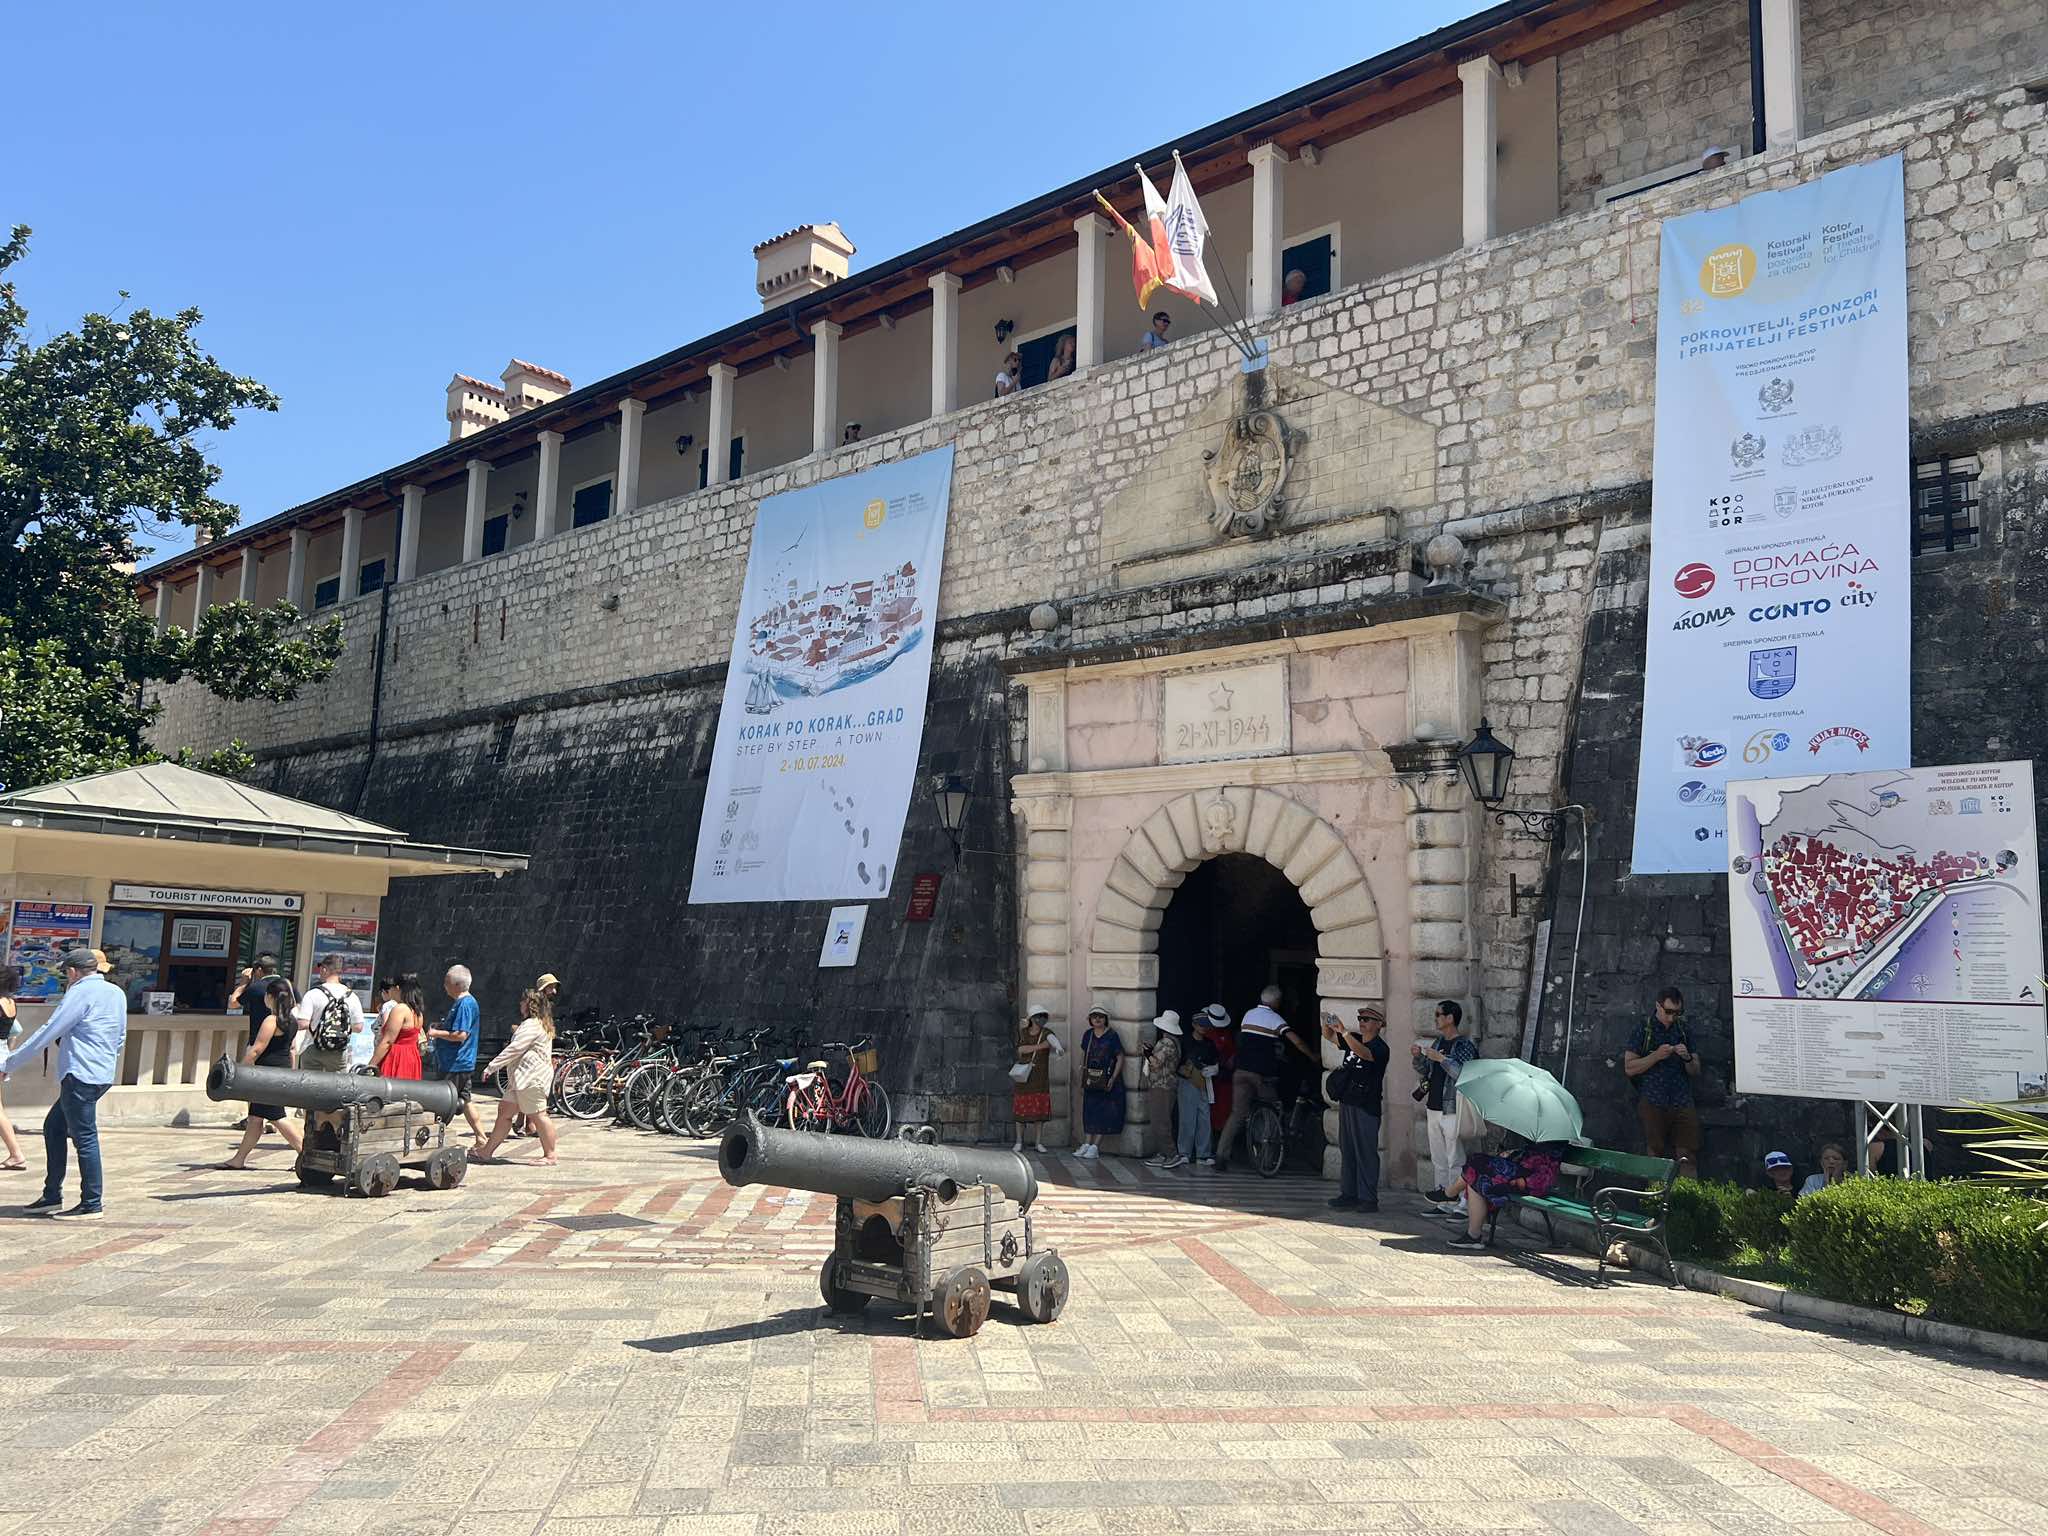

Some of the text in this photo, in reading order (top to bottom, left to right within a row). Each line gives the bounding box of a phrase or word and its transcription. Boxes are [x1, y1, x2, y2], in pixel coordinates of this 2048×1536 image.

[1822, 222, 1852, 234] Kotor
[1822, 225, 1864, 244] Festival
[1768, 232, 1811, 250] Kotorski
[1768, 243, 1805, 258] festival
[1680, 288, 1878, 346] POKROVITELJI, SPONZORI
[1680, 303, 1879, 360] I PRIJATELJI FESTIVALA
[1810, 481, 1845, 494] KULTURNI
[1846, 476, 1874, 486] CENTAR
[1800, 501, 1824, 510] KOTOR
[1725, 534, 1826, 556] GENERALNI SPONZOR FESTIVALA
[1733, 542, 1860, 575] DOMAĆA
[1733, 558, 1879, 592] TRGOVINA
[1672, 586, 1878, 631] AROMA CONTO city
[1722, 630, 1824, 648] SREBRNI SPONZOR FESTIVALA
[1752, 650, 1793, 660] LUKA
[1769, 709, 1804, 718] FESTIVALA
[738, 722, 780, 740] KORAK
[786, 720, 803, 736] PO
[1809, 728, 1836, 747] KNJAZ
[736, 744, 763, 756] STEP
[768, 742, 785, 752] BY
[835, 736, 842, 748] A
[849, 732, 883, 744] TOWN
[1743, 729, 1776, 764] 65
[150, 890, 272, 906] TOURIST INFORMATION
